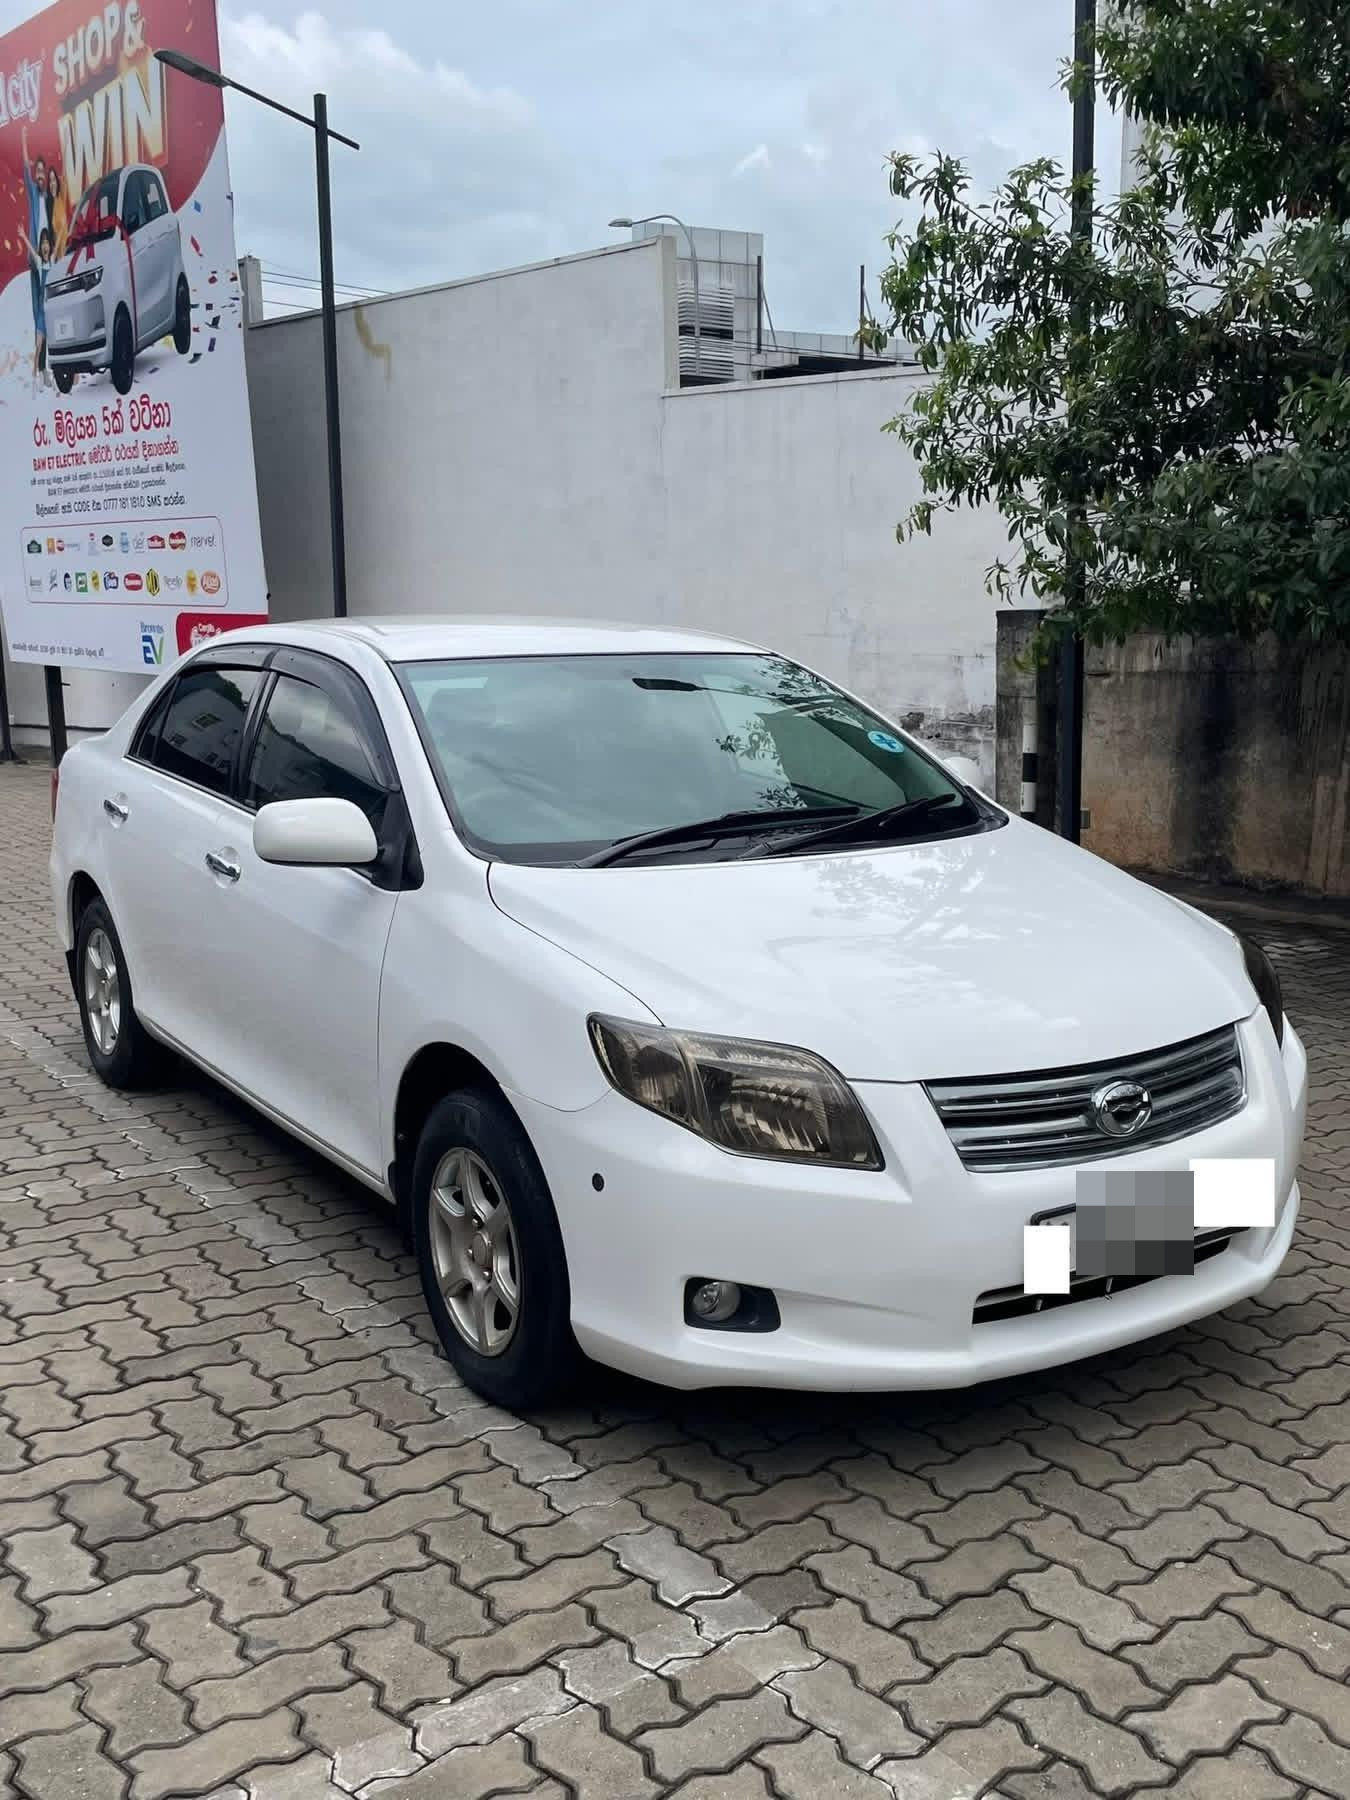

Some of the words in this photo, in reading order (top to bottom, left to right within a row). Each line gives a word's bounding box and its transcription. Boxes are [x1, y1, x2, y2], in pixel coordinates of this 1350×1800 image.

[57, 50, 167, 206] WIN
[54, 409, 97, 448] මිලියන
[129, 393, 171, 432] වටිනා
[73, 500, 91, 513] CODE
[147, 494, 161, 507] SMS
[141, 634, 164, 665] EV
